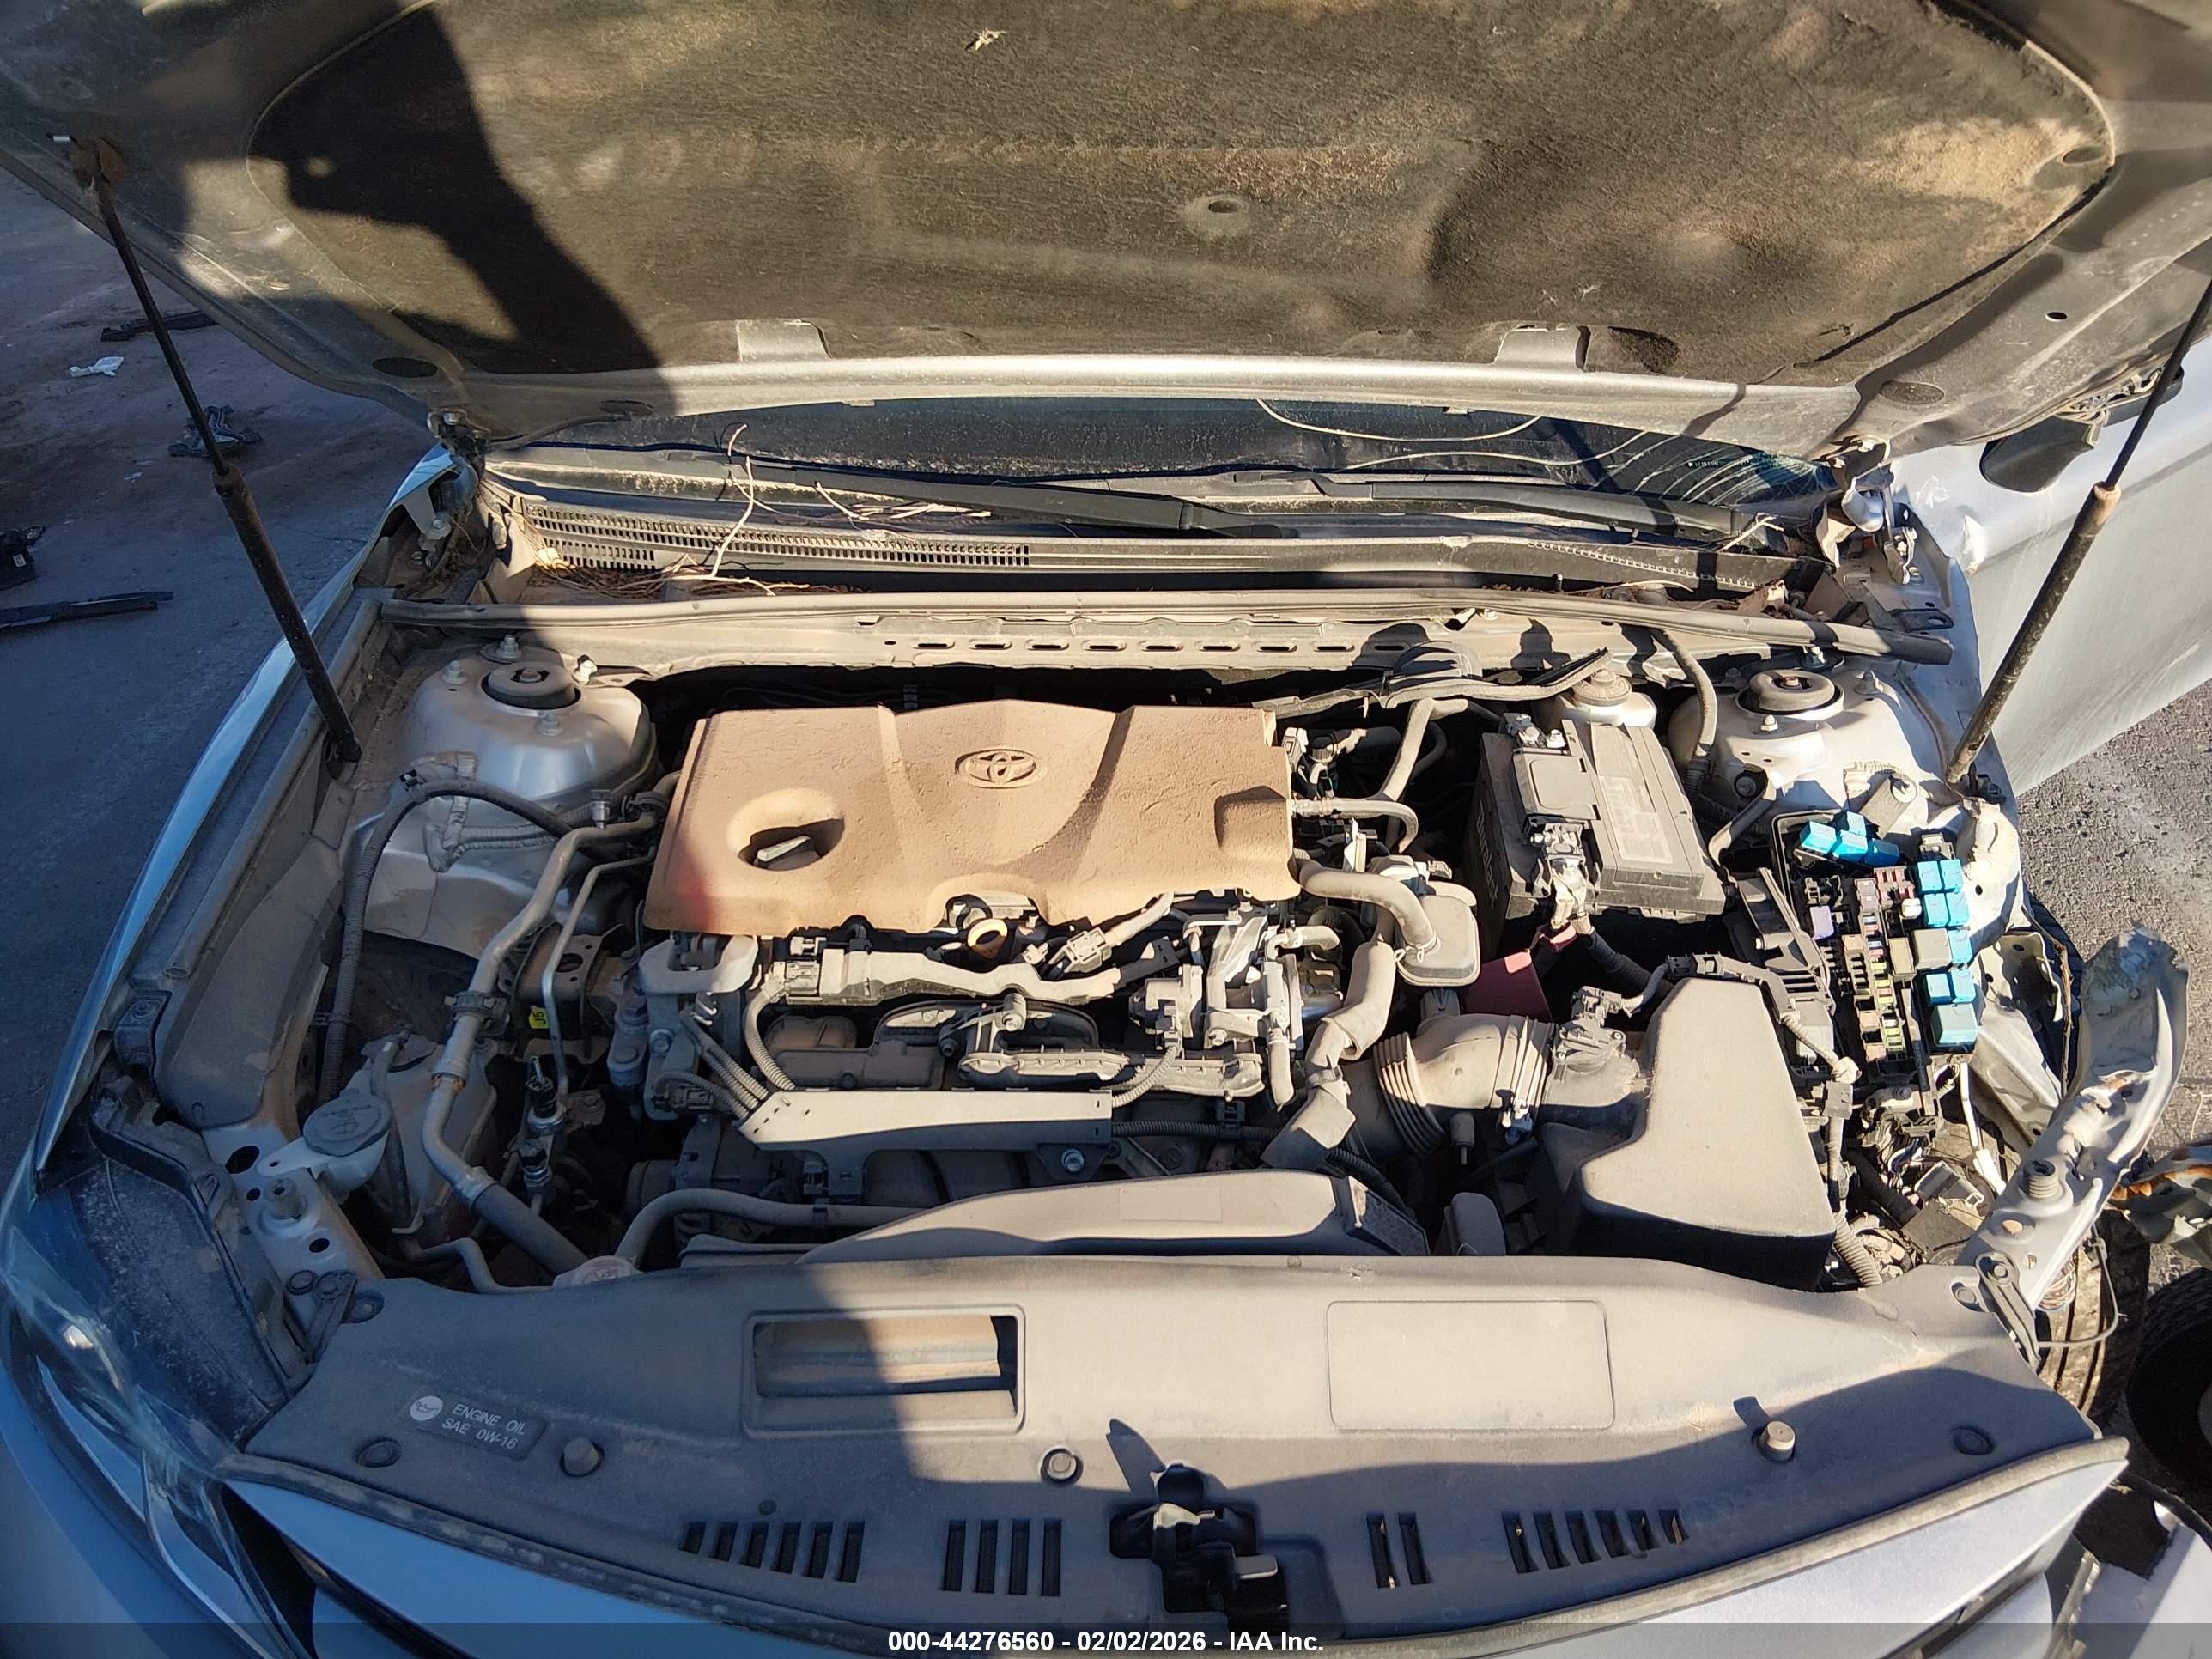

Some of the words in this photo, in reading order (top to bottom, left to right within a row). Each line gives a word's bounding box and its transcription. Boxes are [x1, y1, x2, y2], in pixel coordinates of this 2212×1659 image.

[441, 1418, 472, 1436] SAE
[476, 1429, 519, 1449] 0W-16
[452, 1403, 501, 1428] ENGINE
[506, 1419, 526, 1435] OIL
